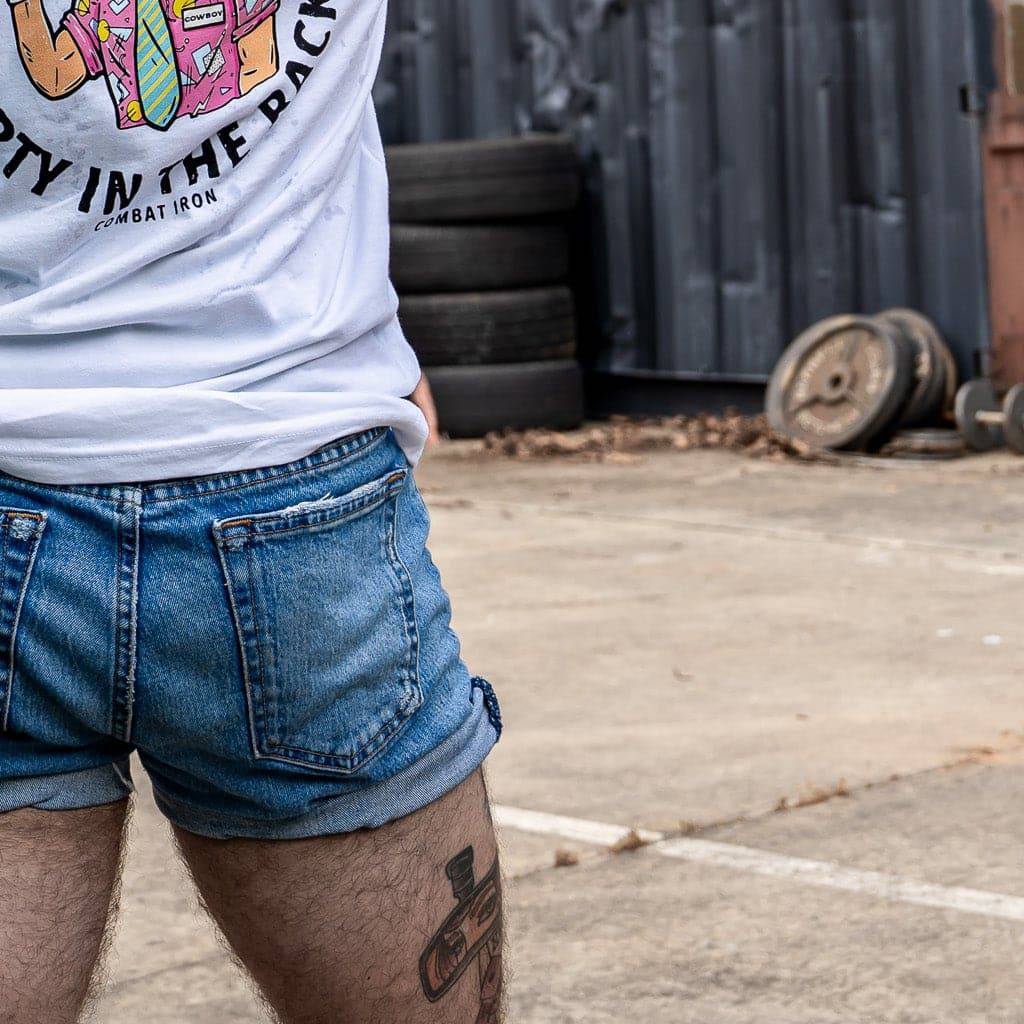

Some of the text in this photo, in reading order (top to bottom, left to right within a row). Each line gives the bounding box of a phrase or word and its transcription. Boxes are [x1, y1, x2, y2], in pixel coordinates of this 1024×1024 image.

[184, 10, 223, 23] COWBOY
[78, 166, 142, 215] IN
[158, 121, 251, 195] THE
[94, 188, 218, 232] COMBAT IRON
